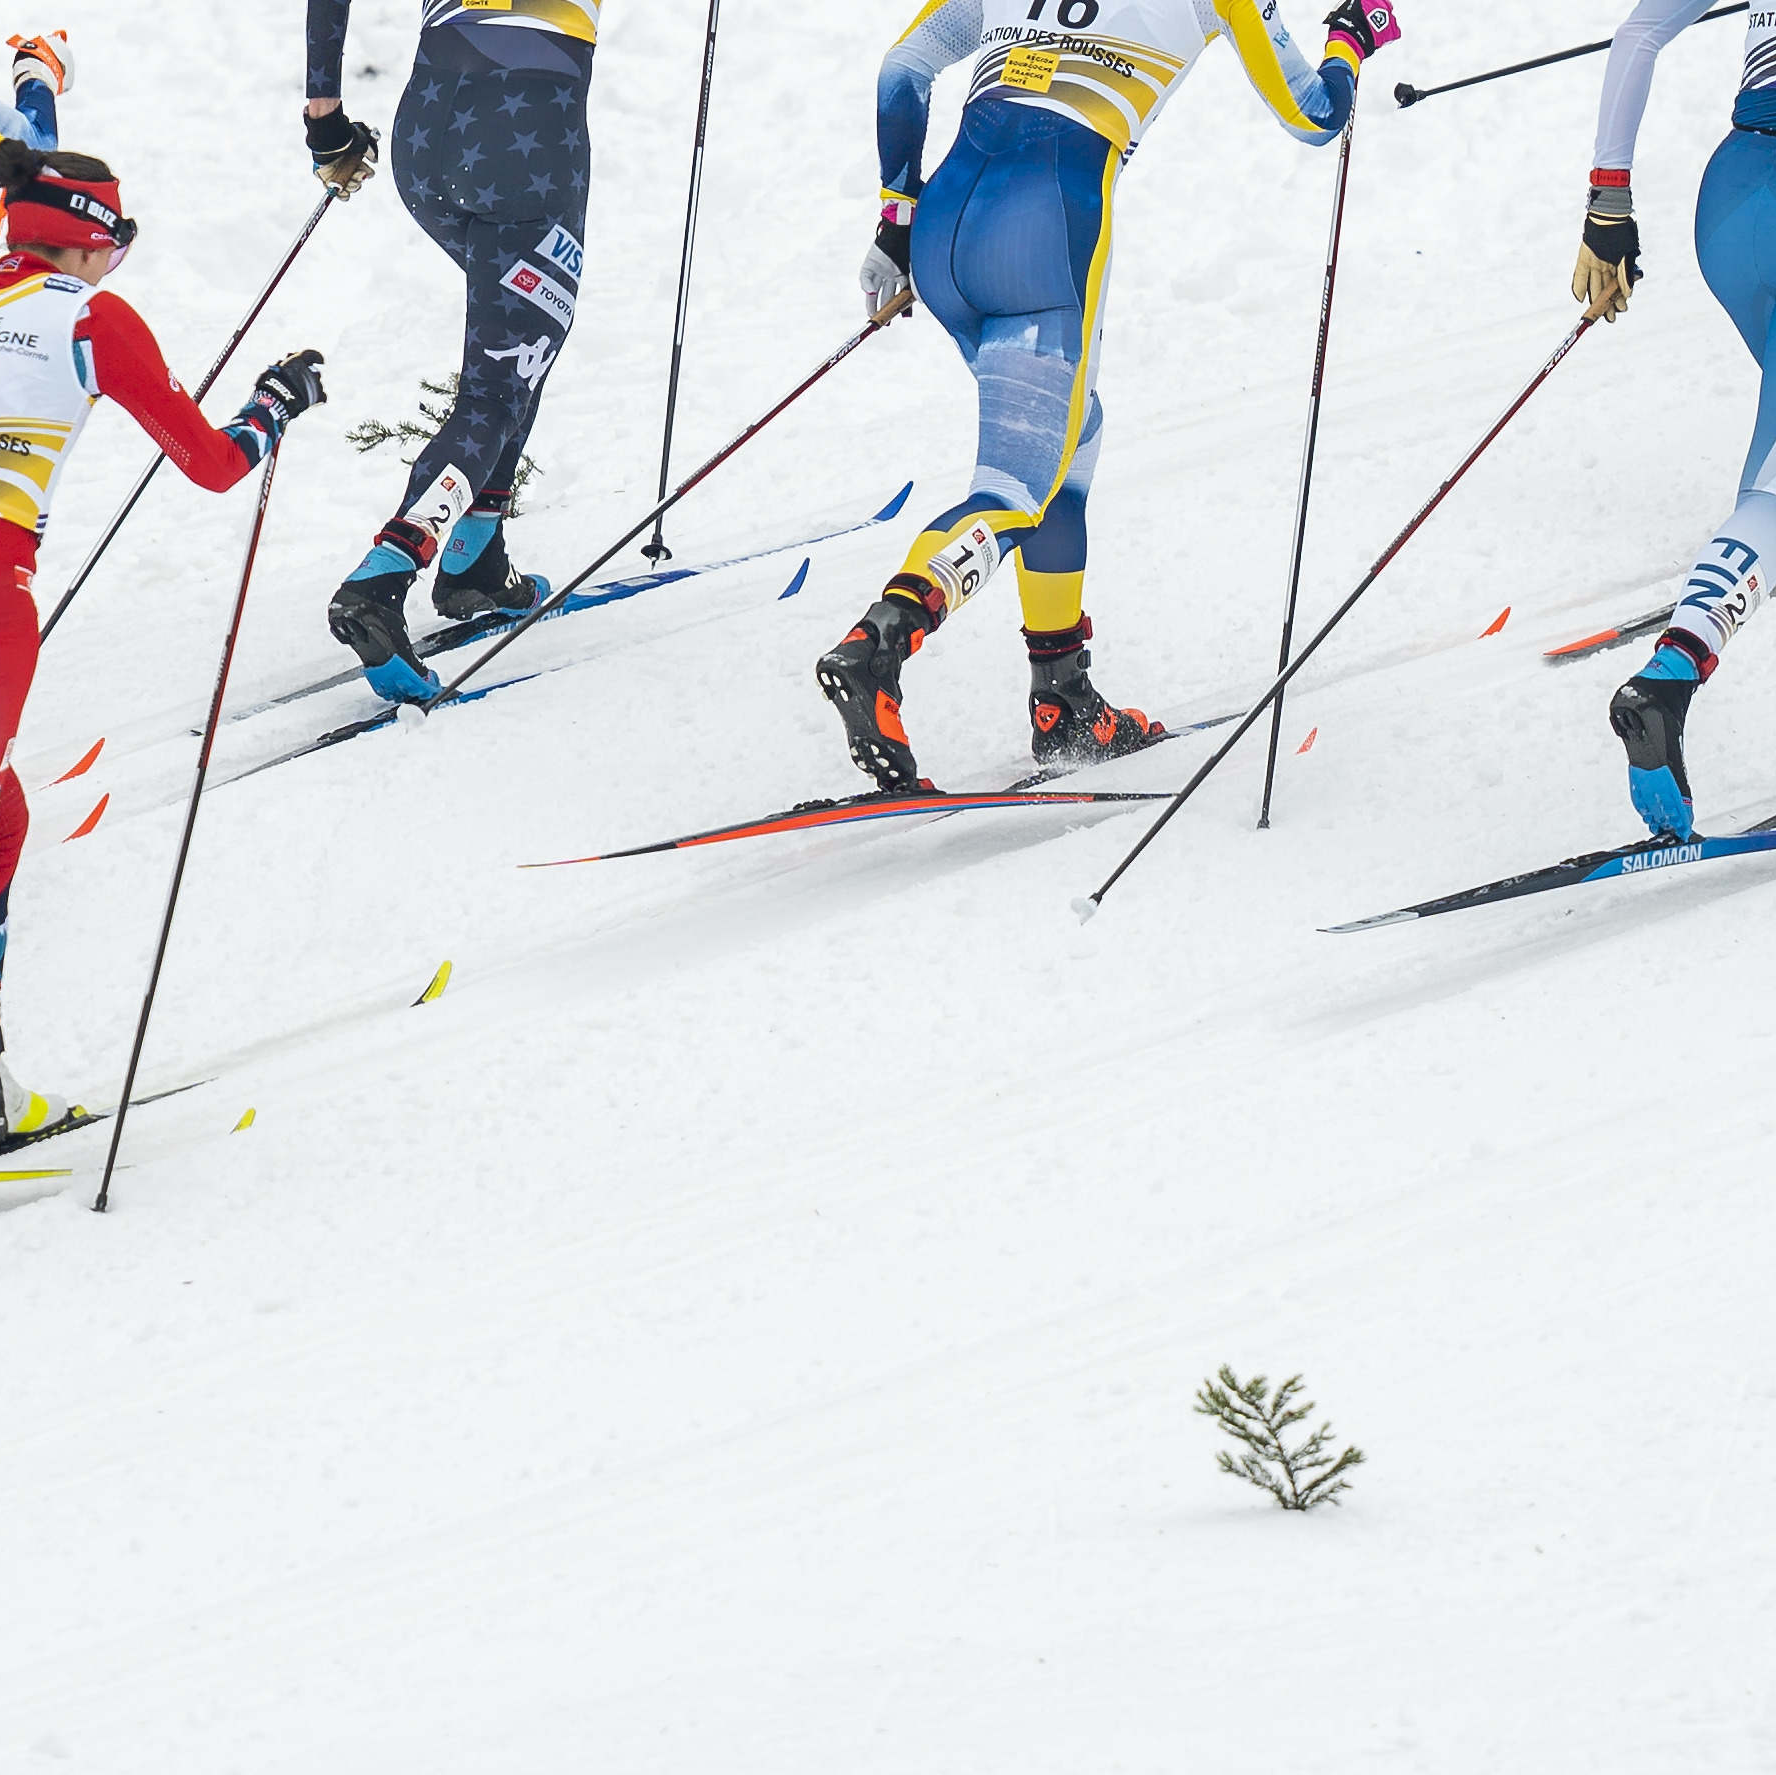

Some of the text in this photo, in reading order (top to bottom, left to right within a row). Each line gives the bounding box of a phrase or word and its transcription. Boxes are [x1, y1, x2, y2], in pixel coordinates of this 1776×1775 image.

[1025, 28, 1059, 46] DES
[1060, 34, 1136, 78] ROUSSES
[264, 376, 296, 402] SWIX
[952, 544, 981, 597] 16
[1621, 843, 1702, 875] SALOMON
